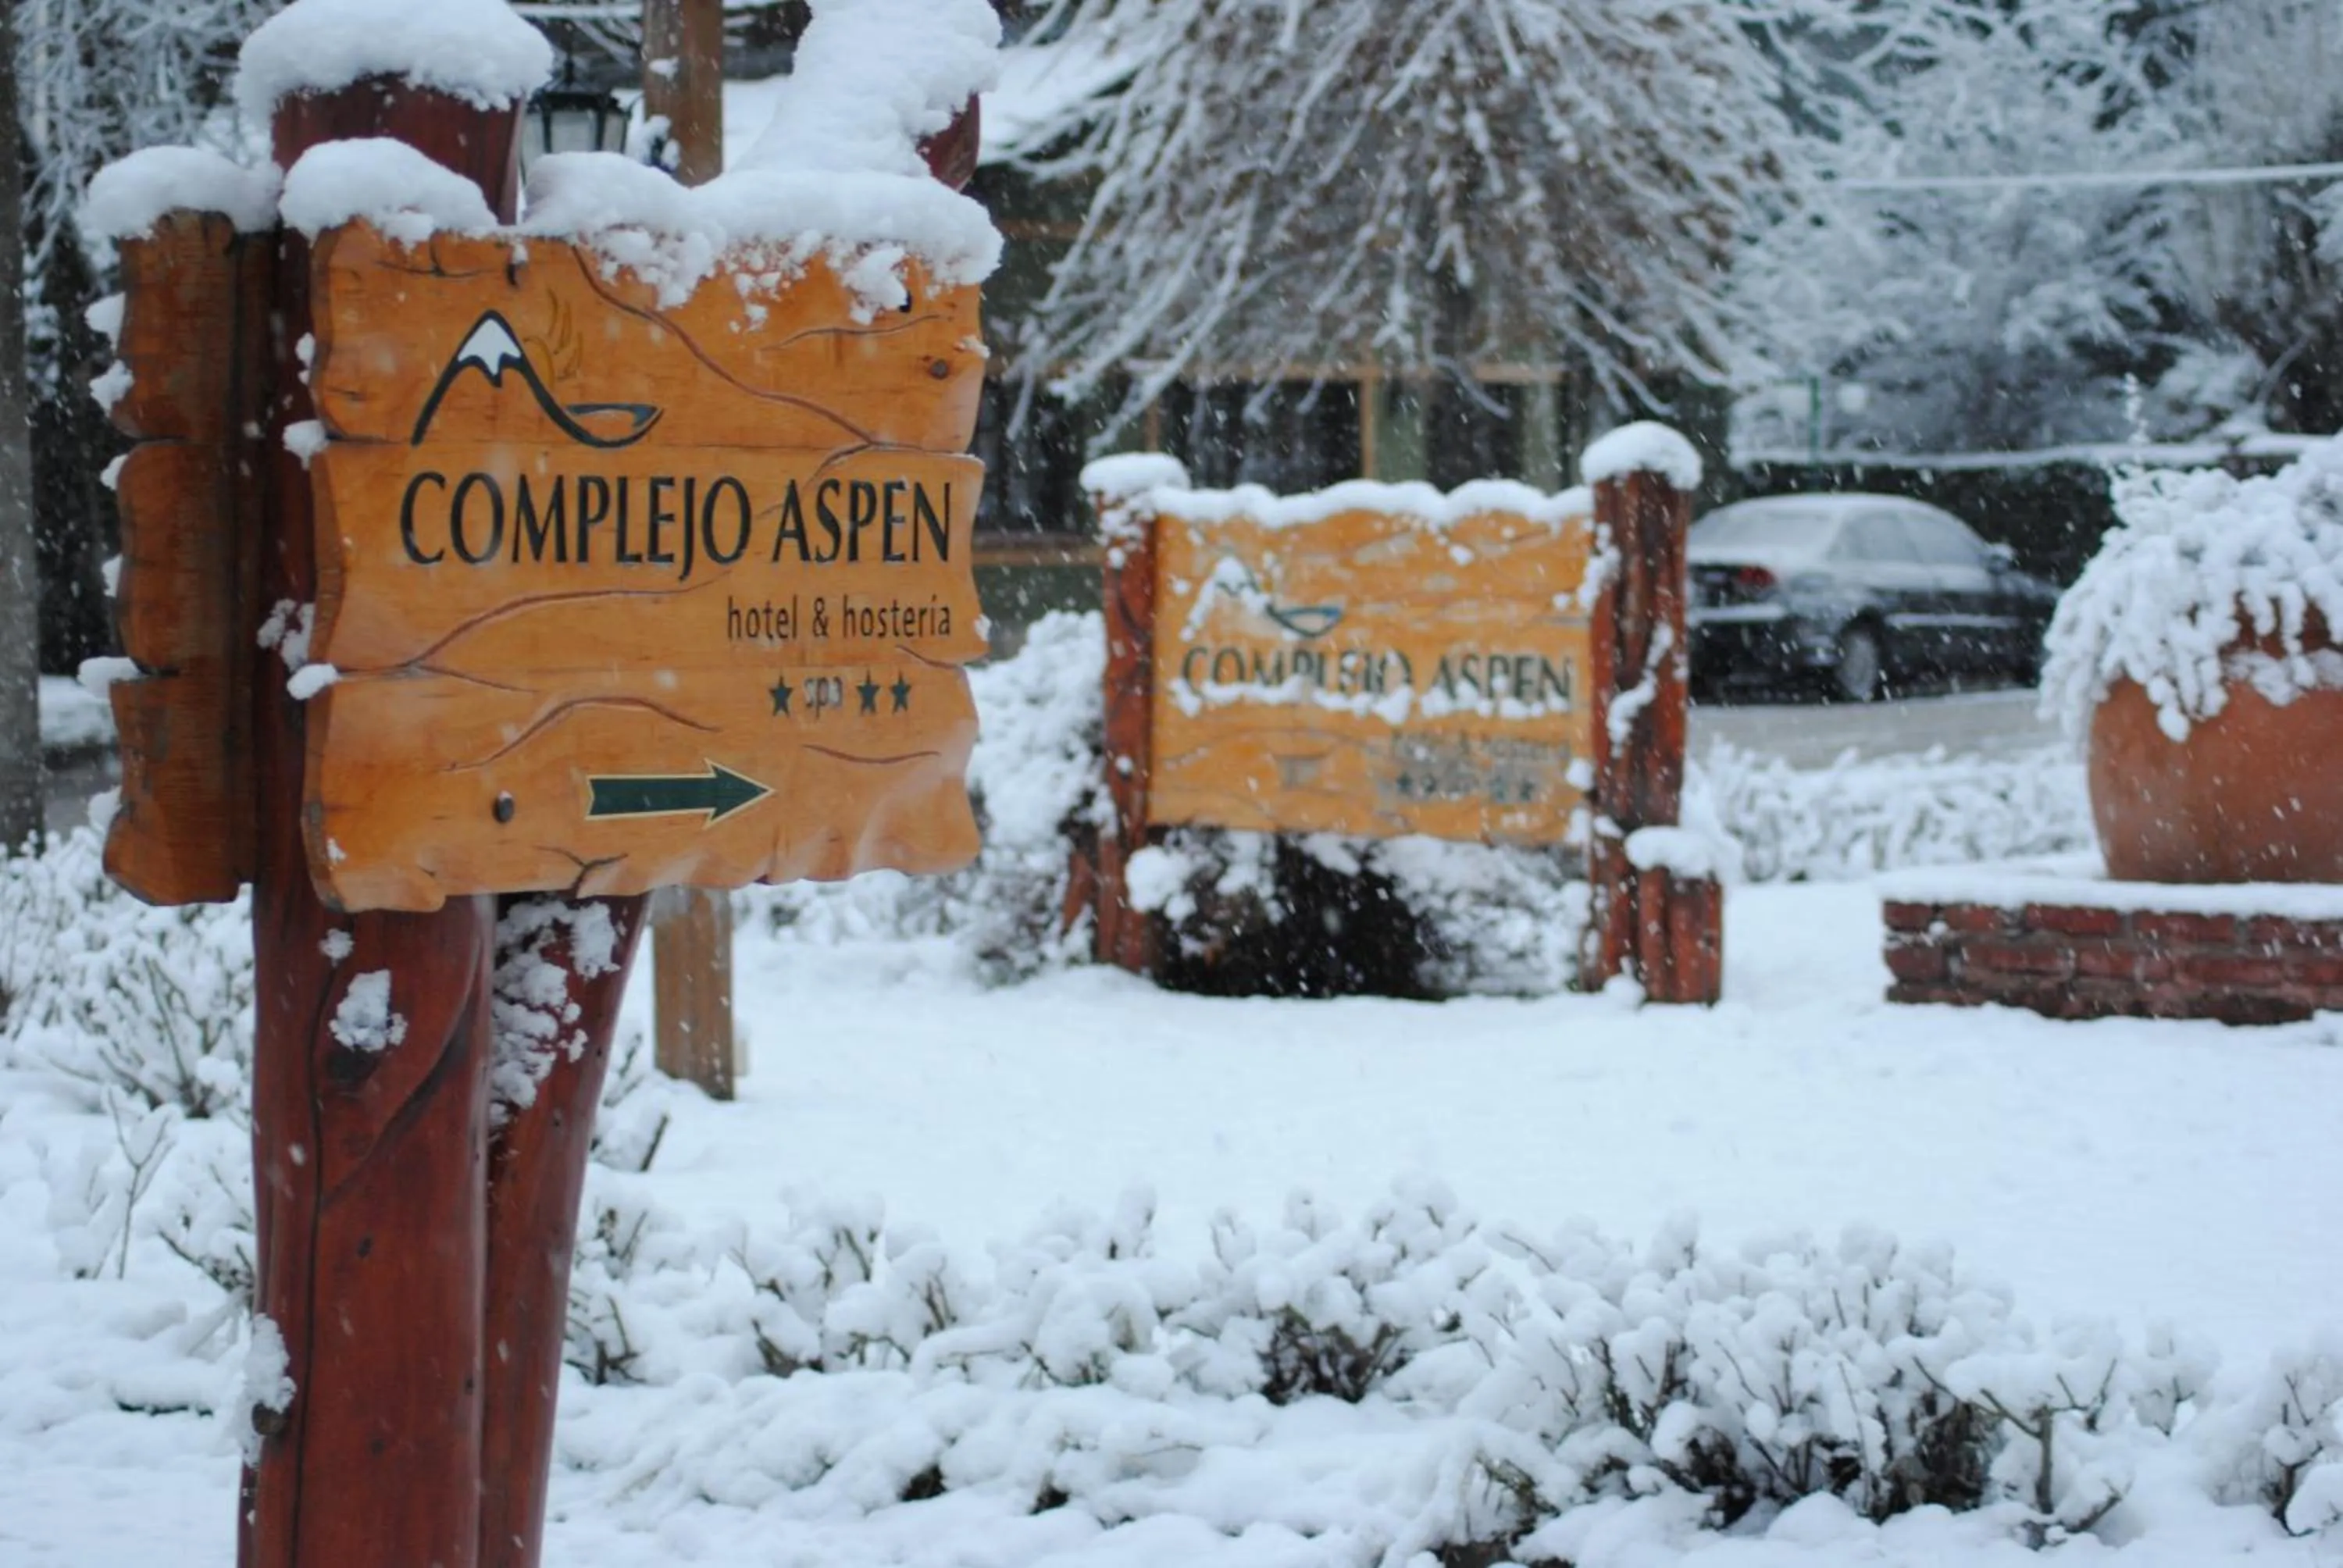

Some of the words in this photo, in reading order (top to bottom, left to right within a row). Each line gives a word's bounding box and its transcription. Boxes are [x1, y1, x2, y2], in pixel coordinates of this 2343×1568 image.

[399, 471, 752, 582] COMPLEJO
[772, 476, 951, 564] ASPEN
[727, 594, 797, 640] hotel
[812, 597, 829, 639] &
[1428, 654, 1571, 704] ASPEN
